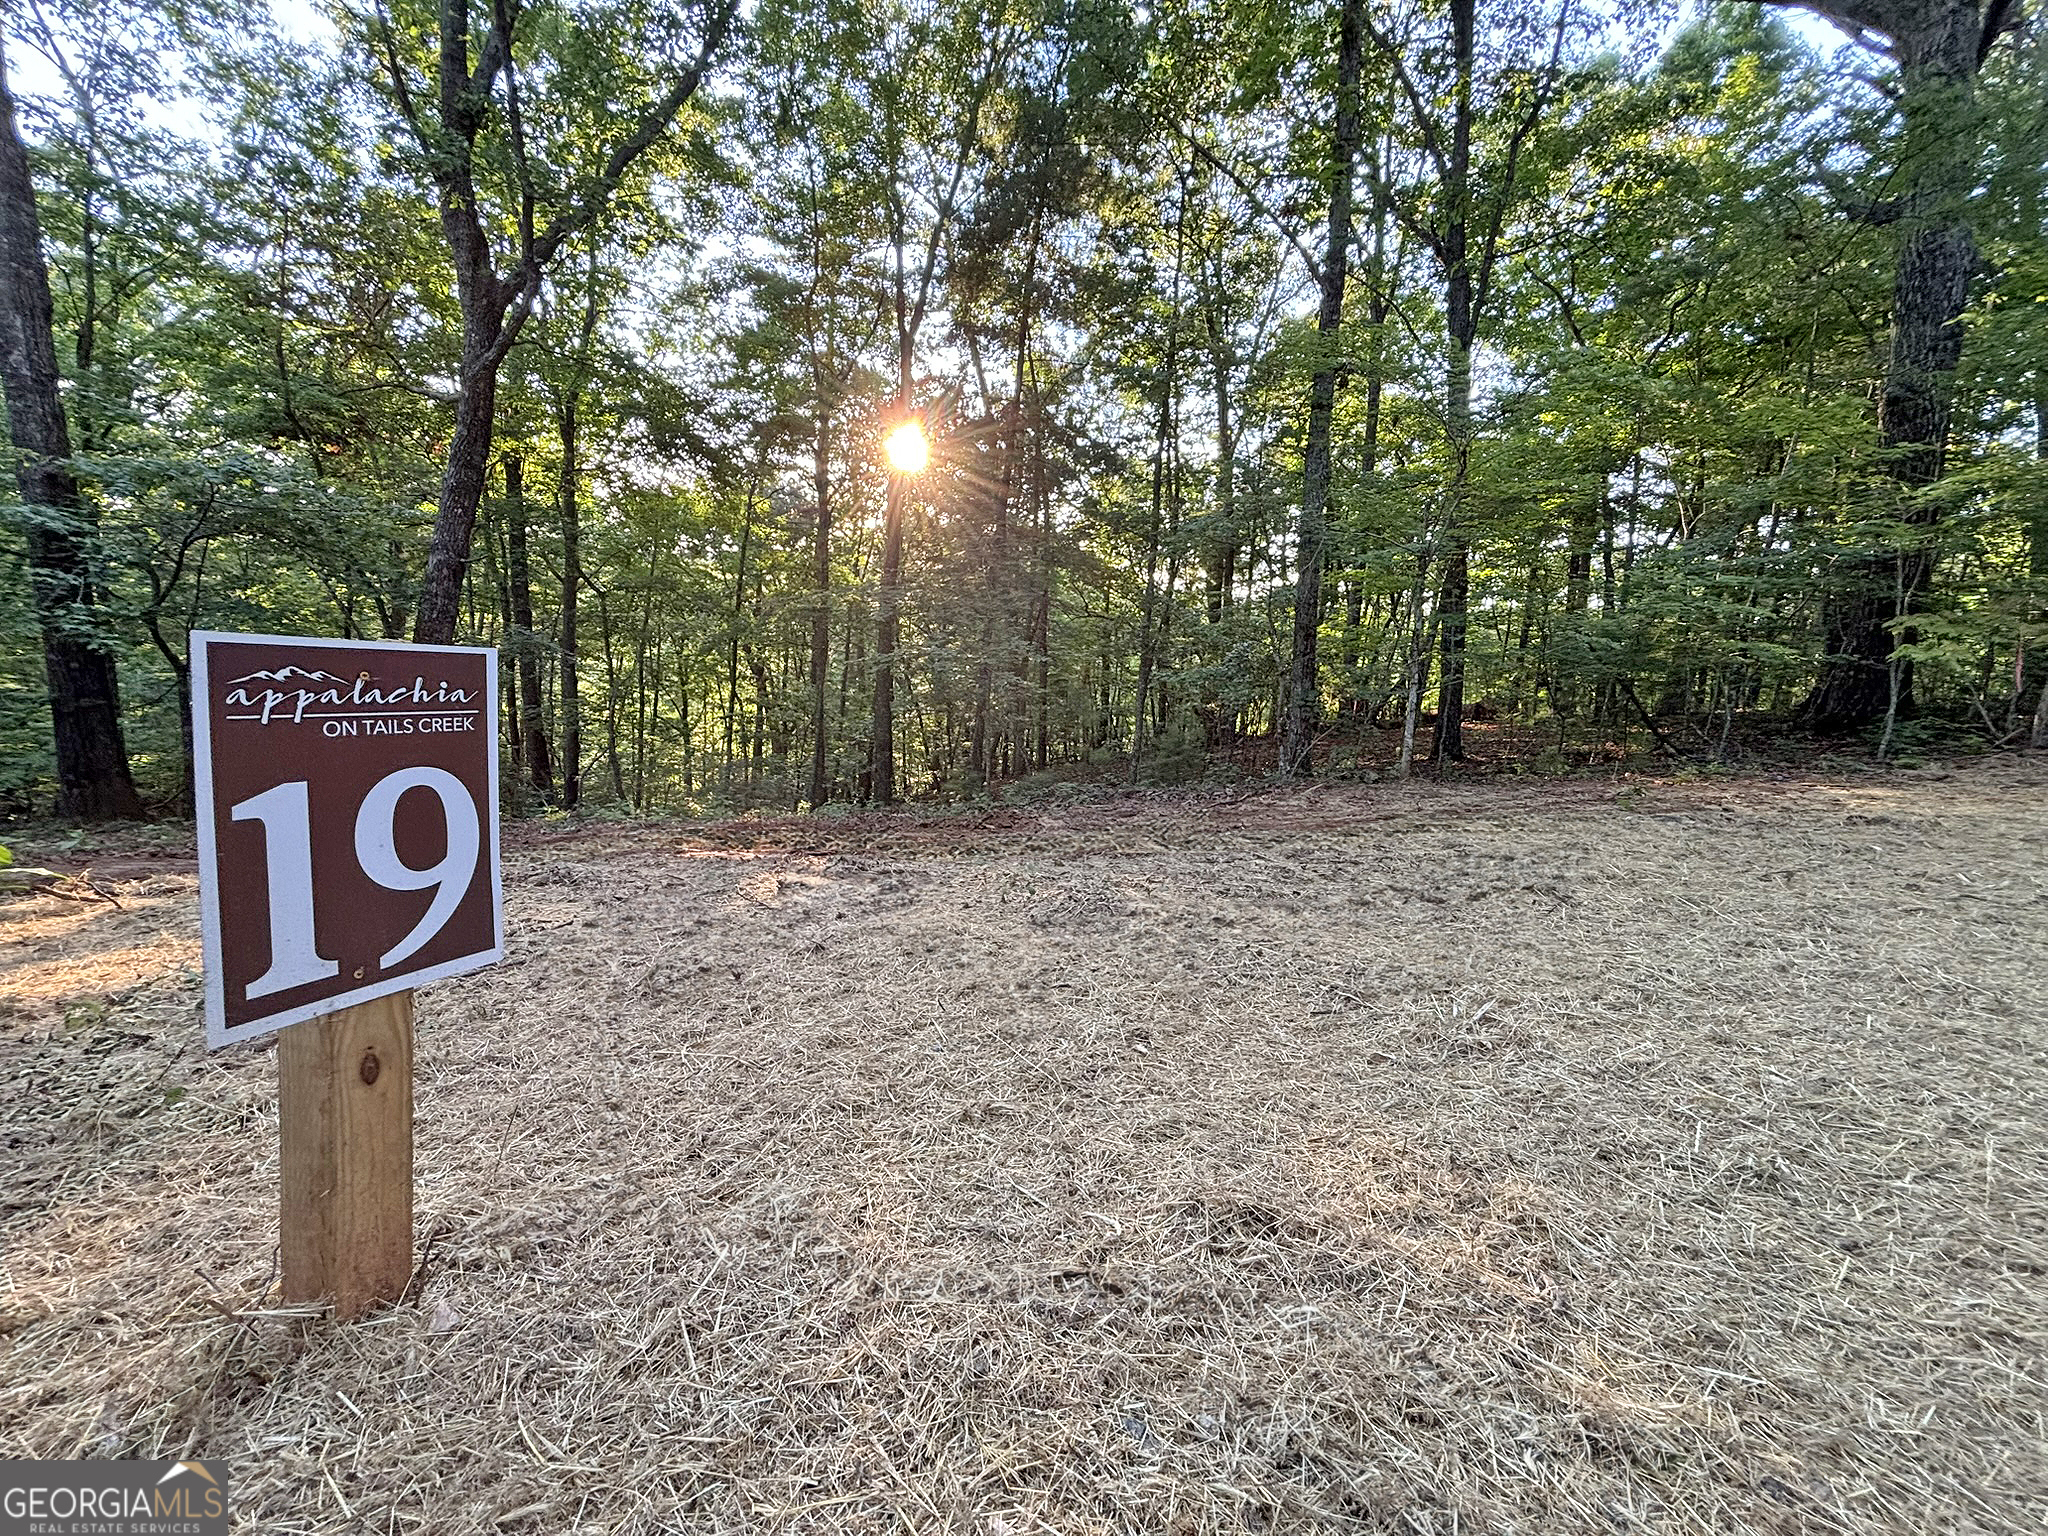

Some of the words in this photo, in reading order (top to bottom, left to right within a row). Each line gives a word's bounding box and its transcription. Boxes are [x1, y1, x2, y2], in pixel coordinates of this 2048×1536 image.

[225, 676, 479, 725] appalachia
[322, 721, 357, 738] ON
[362, 719, 413, 735] TAILS
[418, 716, 475, 733] CREEK
[231, 766, 480, 1001] 19
